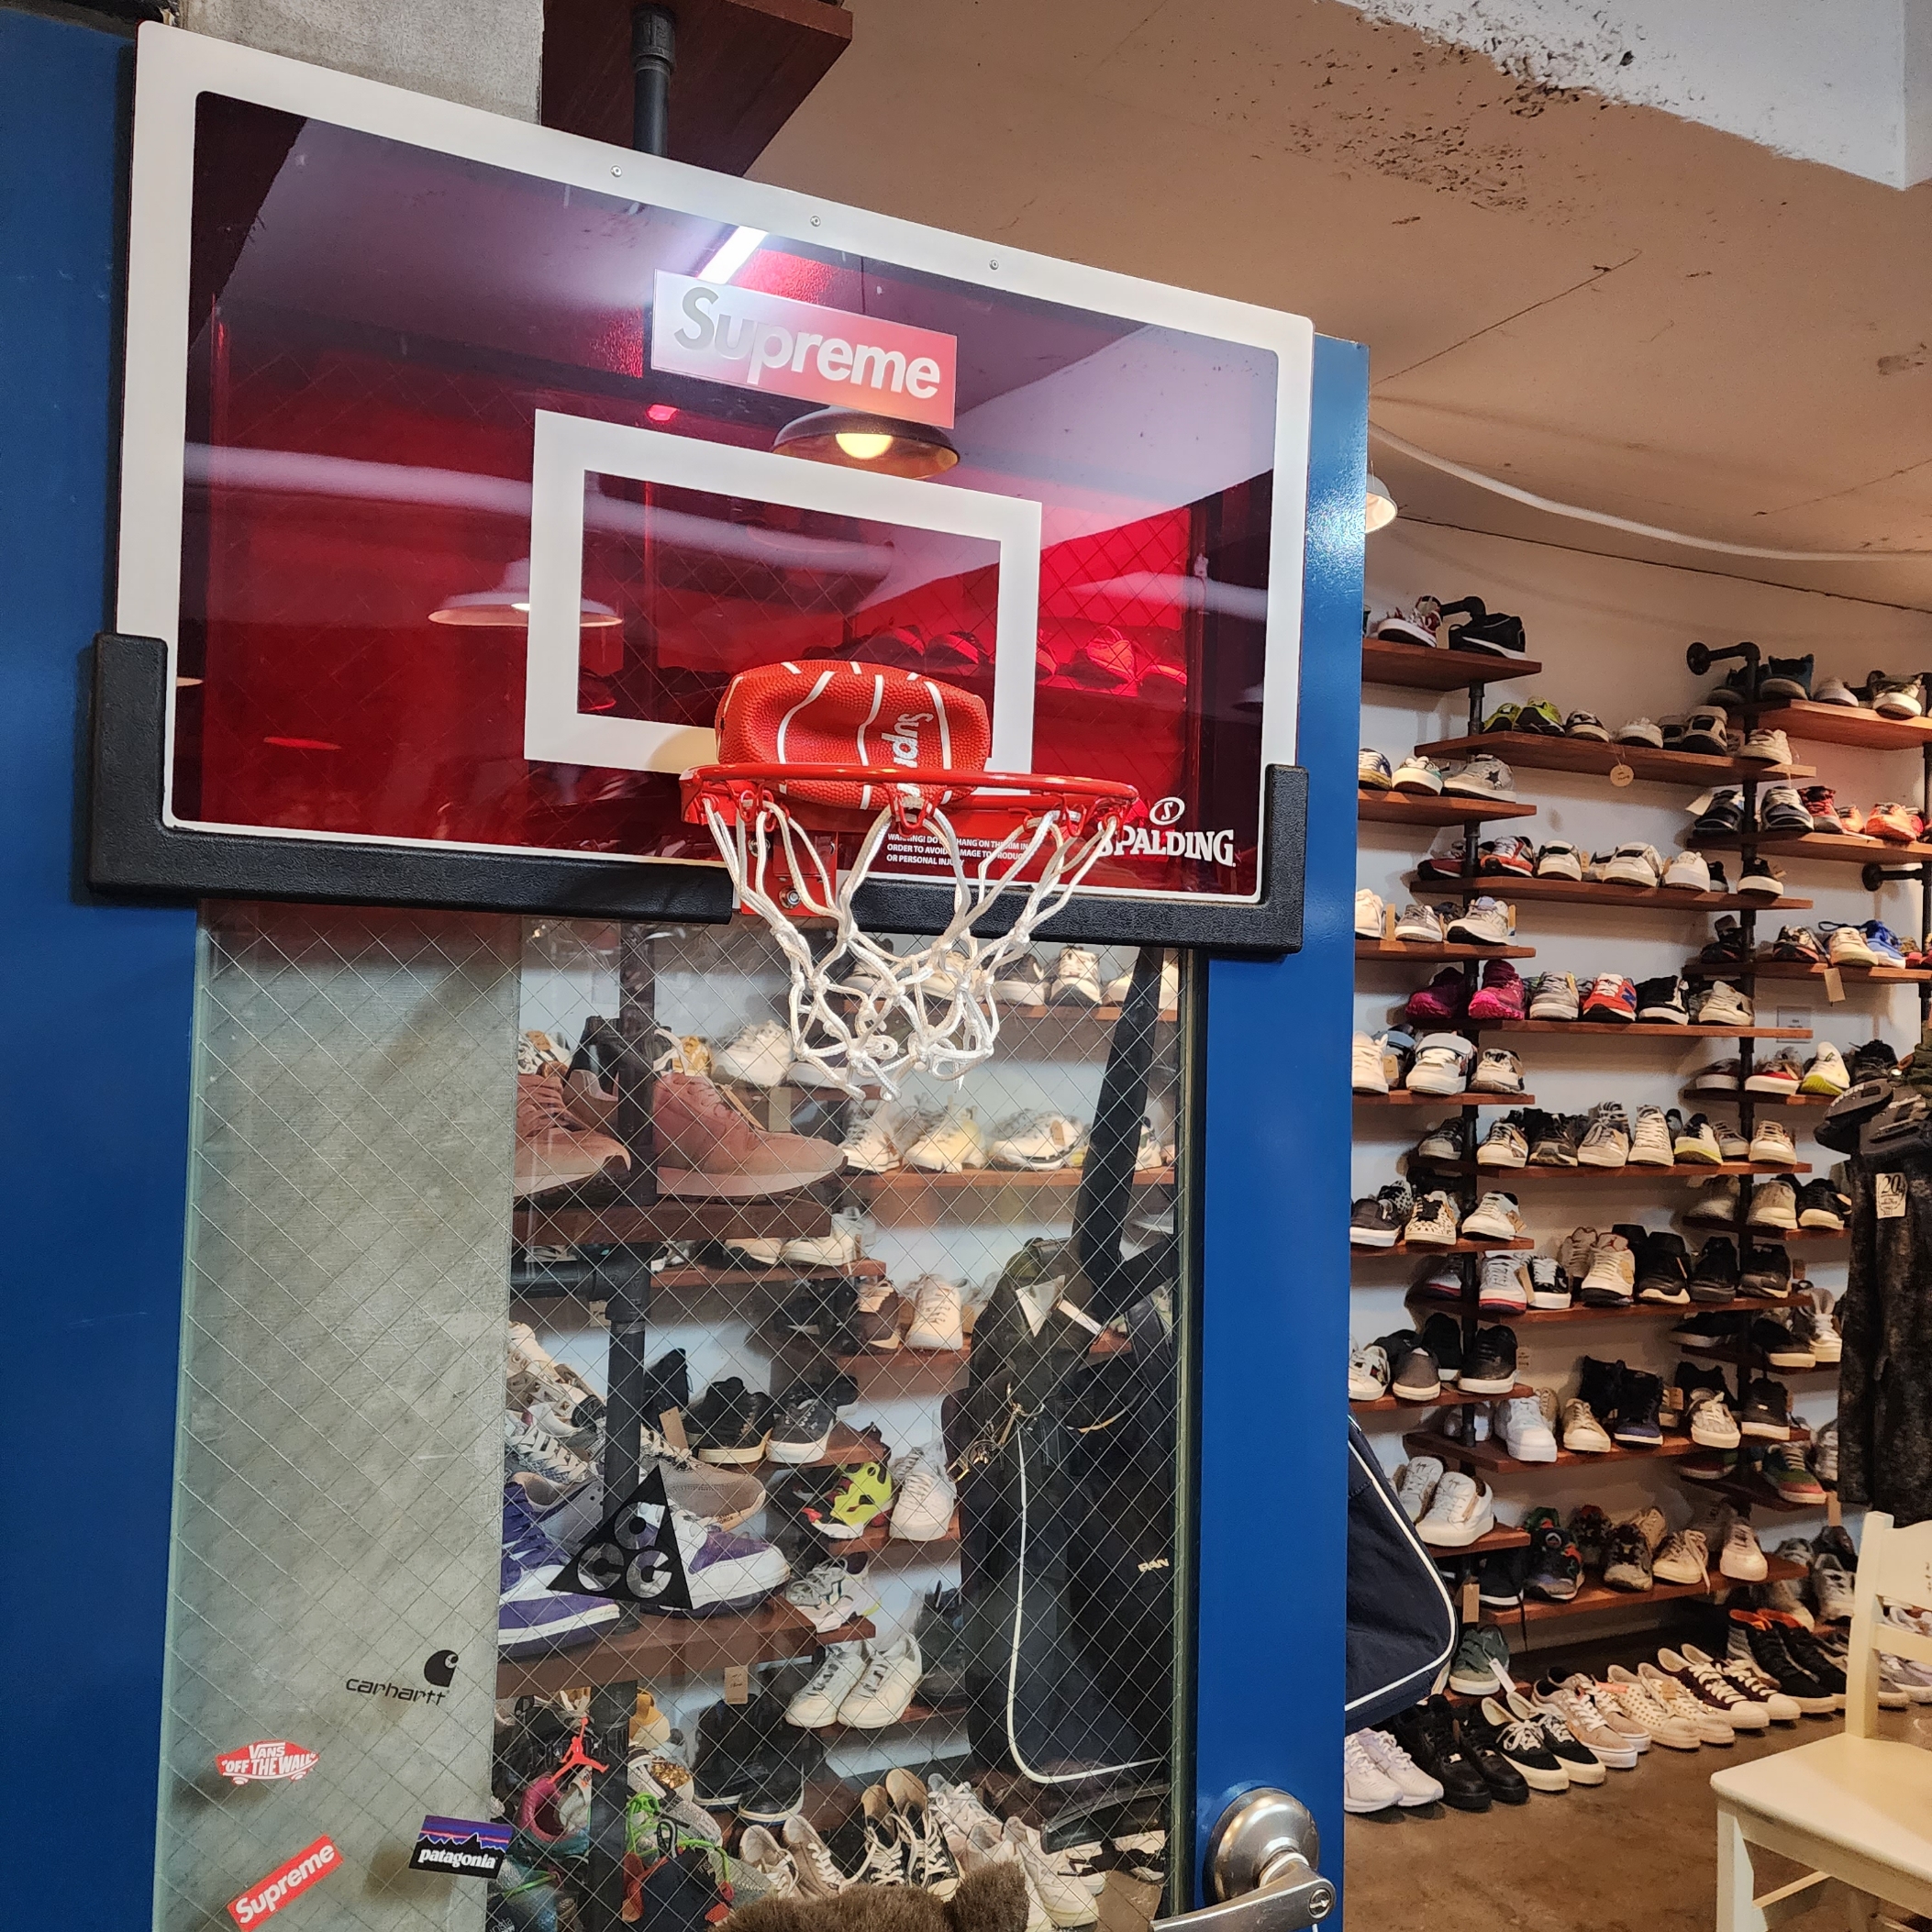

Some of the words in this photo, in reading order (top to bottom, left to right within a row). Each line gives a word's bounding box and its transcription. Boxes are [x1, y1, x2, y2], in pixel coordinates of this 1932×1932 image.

[674, 286, 940, 399] Supreme
[881, 713, 934, 796] Supr
[887, 833, 926, 844] WAING!
[927, 836, 938, 844] DO
[956, 838, 978, 848] HANG
[978, 839, 990, 849] ON
[1097, 821, 1235, 867] SPALDING
[886, 843, 913, 853] ORDER
[914, 845, 925, 854] TO
[925, 846, 949, 855] AVOID
[959, 849, 982, 858] MAGE
[982, 850, 993, 859] TO
[995, 851, 1026, 861] RODUC
[886, 853, 898, 862] OR
[898, 854, 938, 865] PERSONAL
[938, 857, 964, 867] INJUY
[346, 1678, 446, 1706] carhartt
[249, 1742, 286, 1760] VANS
[250, 1756, 277, 1776] THE
[417, 1849, 496, 1869] patagonia
[235, 1844, 336, 1924] Supreme
